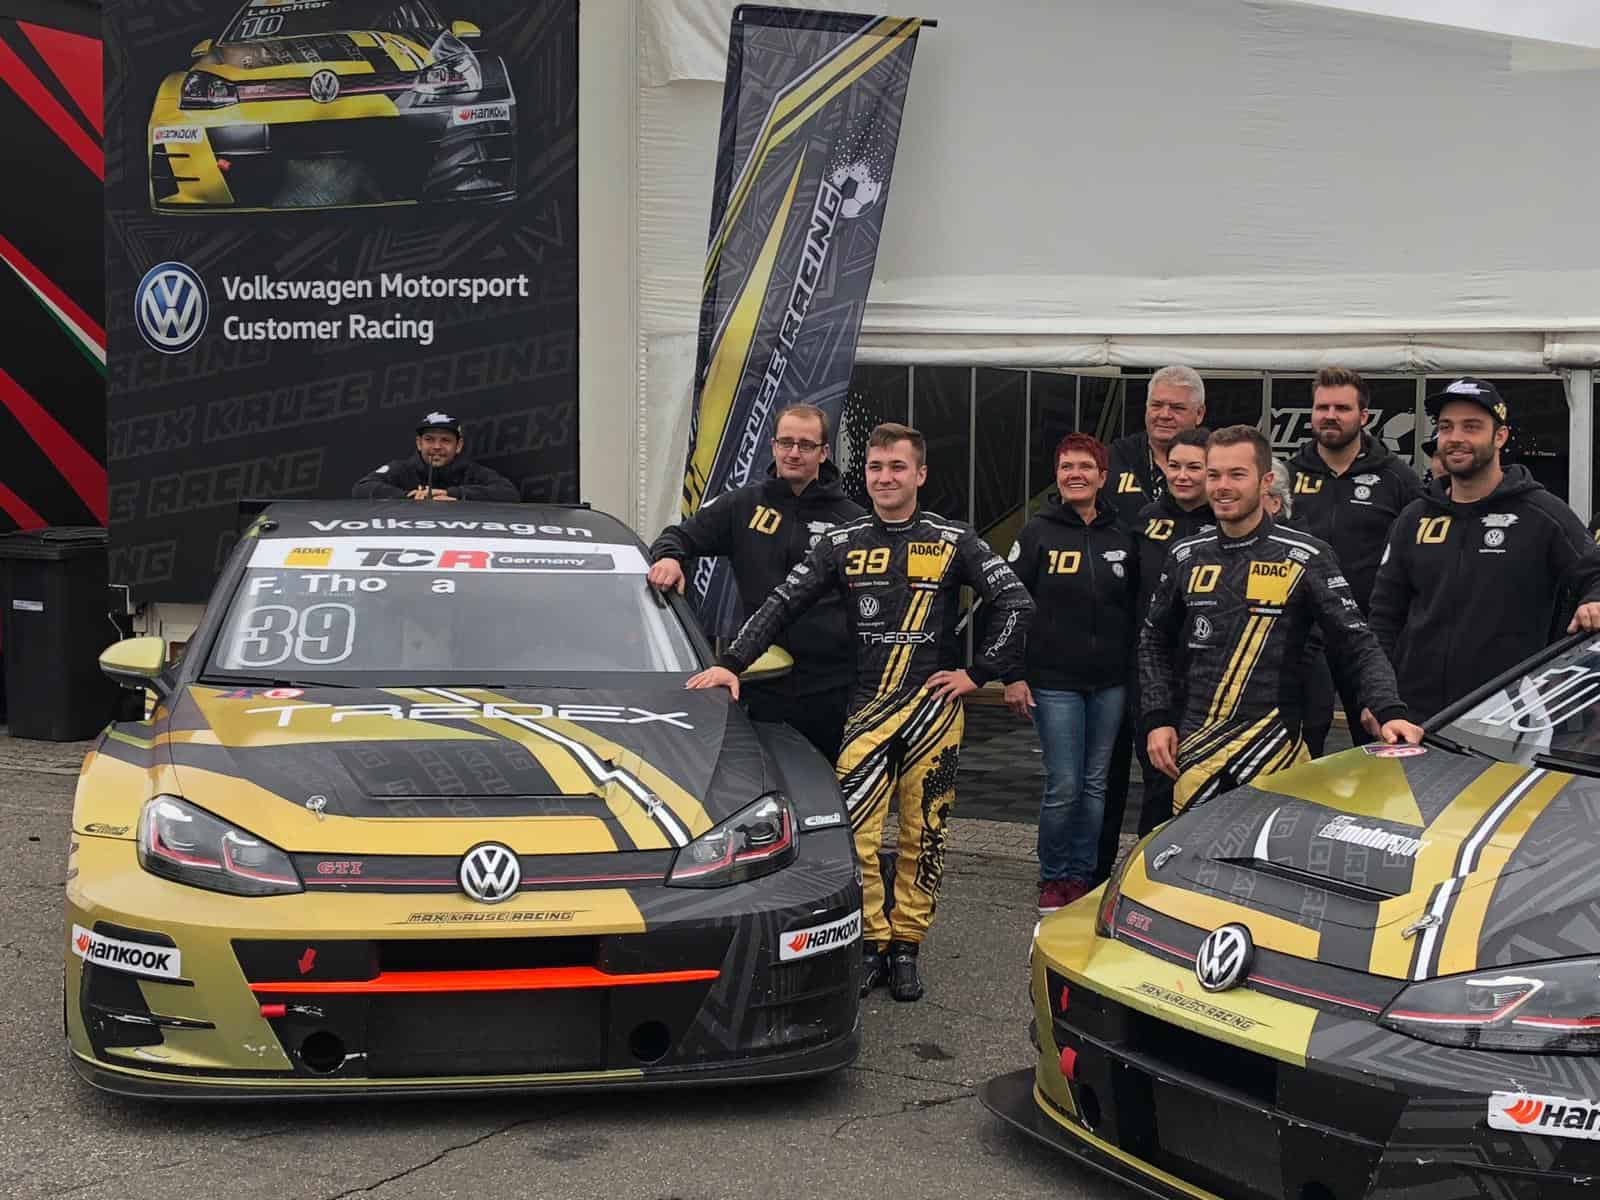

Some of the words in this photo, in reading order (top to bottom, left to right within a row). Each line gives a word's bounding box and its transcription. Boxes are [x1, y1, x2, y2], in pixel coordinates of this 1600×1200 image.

[241, 15, 284, 38] 10
[777, 178, 846, 350] RACING
[222, 275, 373, 305] Volkswagen
[380, 273, 529, 303] Motorsport
[223, 315, 342, 340] Customer
[349, 313, 434, 345] Racing
[308, 517, 593, 538] Volkswagen
[748, 504, 783, 536] 10
[1144, 518, 1175, 541] 10
[1416, 515, 1453, 545] 10
[355, 547, 493, 569] TCR
[498, 554, 585, 567] Germany
[845, 547, 891, 576] 39
[909, 543, 941, 557] ADAC
[1048, 550, 1081, 574] 10
[1251, 563, 1289, 578] ADAC
[249, 575, 283, 596] F.
[1187, 564, 1223, 594] 10
[238, 602, 356, 668] 39
[857, 631, 936, 645] TREDEX
[247, 702, 695, 730] TREDEX
[316, 861, 363, 875] GTI
[511, 910, 574, 922] RACING
[1126, 910, 1153, 932] GTI
